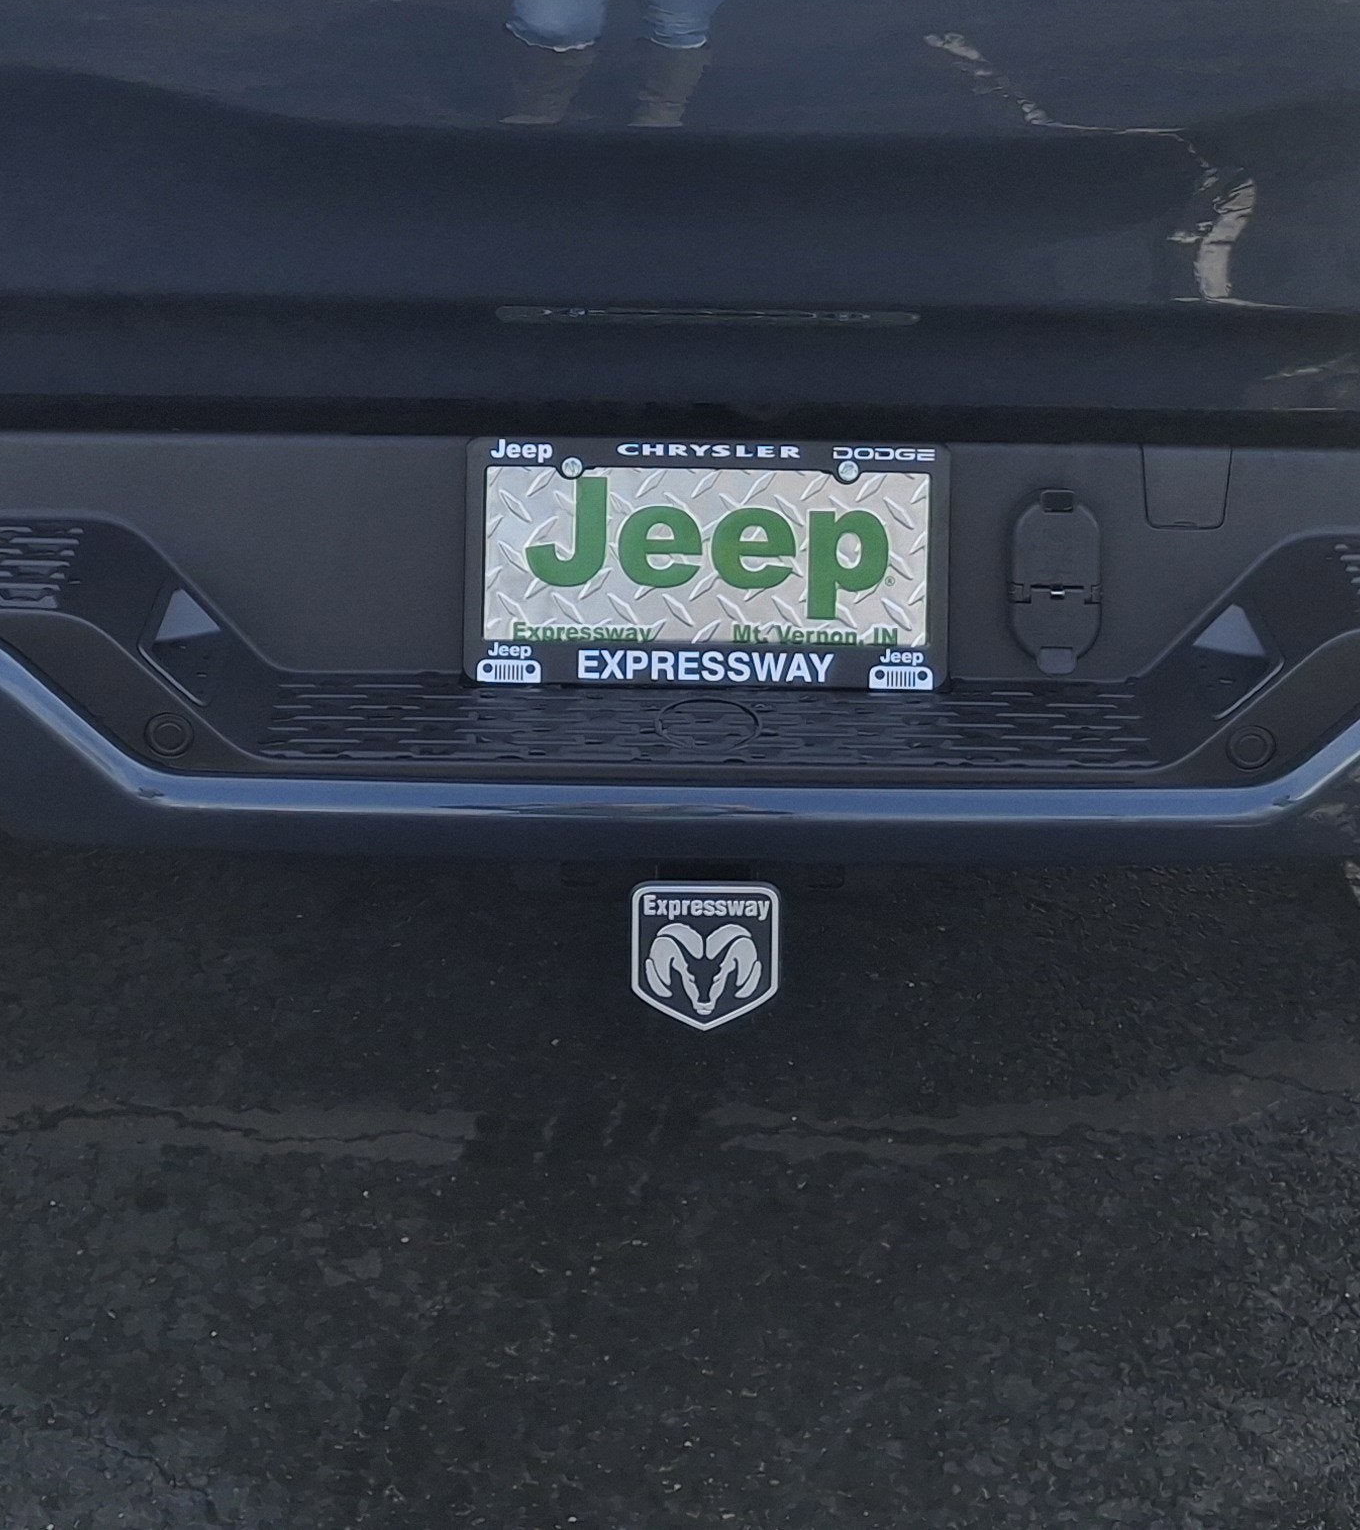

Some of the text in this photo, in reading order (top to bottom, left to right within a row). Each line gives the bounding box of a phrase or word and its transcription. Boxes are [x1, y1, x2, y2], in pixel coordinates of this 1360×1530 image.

[490, 438, 553, 463] Jeep
[616, 442, 800, 459] CHRYSLER
[832, 446, 936, 461] DODGE
[525, 476, 890, 620] Jeep
[512, 621, 653, 643] Expressway
[732, 623, 768, 644] Mt.
[873, 627, 899, 647] IN
[487, 641, 533, 660] Jeep
[879, 648, 924, 666] Jeep
[577, 648, 834, 684] EXPRESSWAY
[643, 894, 771, 921] Expressway
